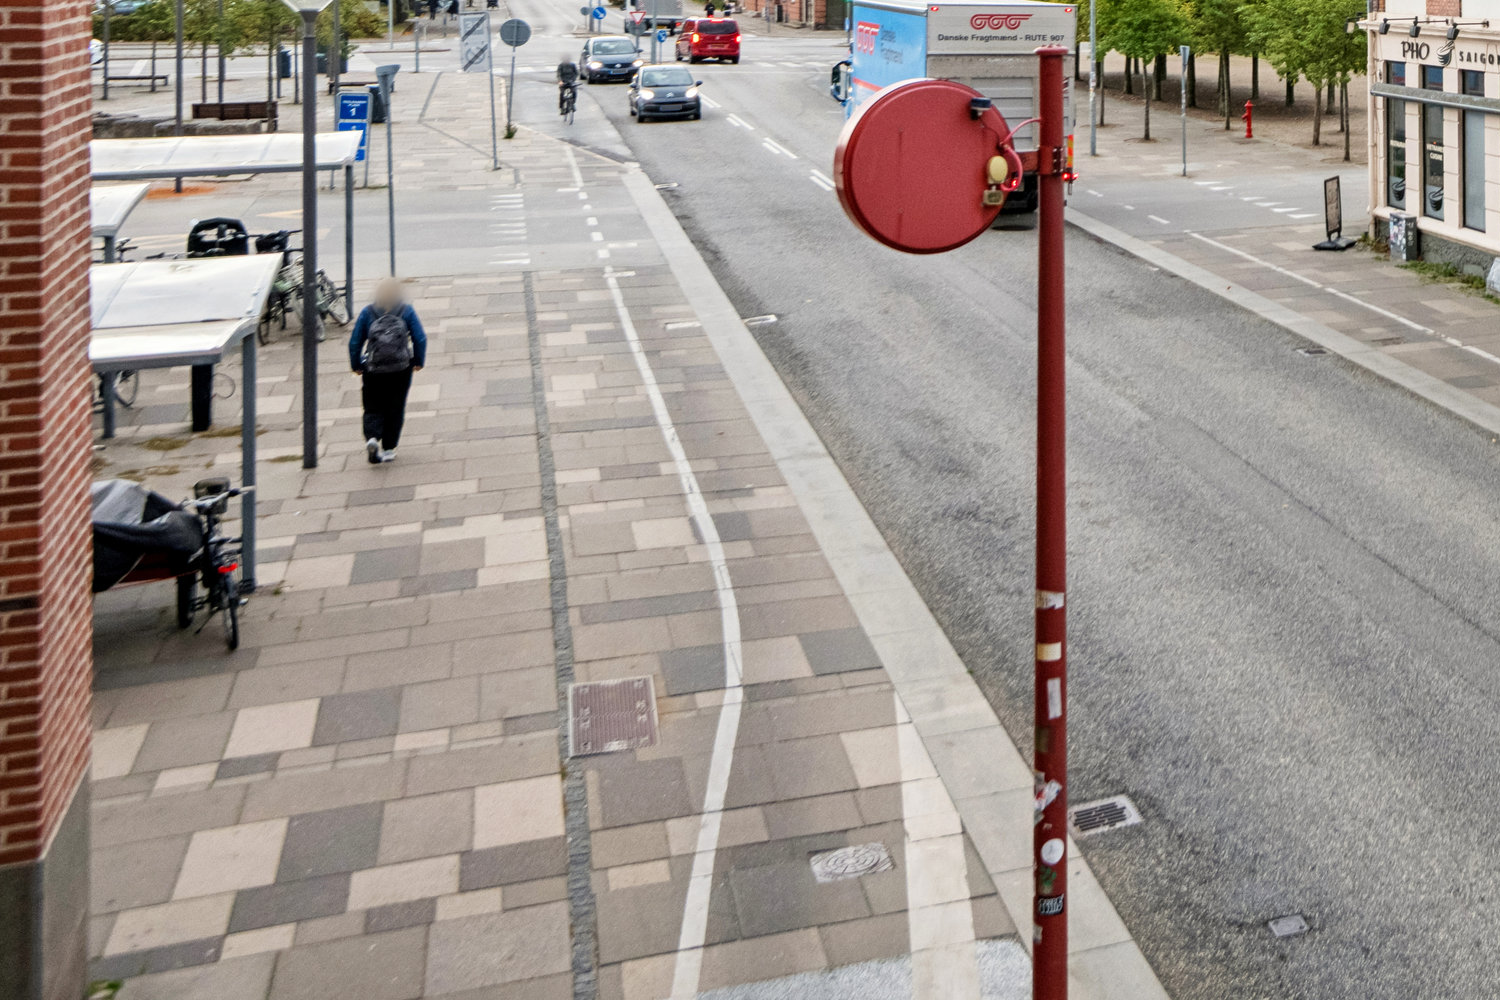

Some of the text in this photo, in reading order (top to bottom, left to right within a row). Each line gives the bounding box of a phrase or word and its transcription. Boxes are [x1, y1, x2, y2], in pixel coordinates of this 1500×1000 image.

[937, 33, 969, 41] Danske
[971, 33, 1018, 43] Fragtmænd
[1400, 41, 1430, 60] PHO
